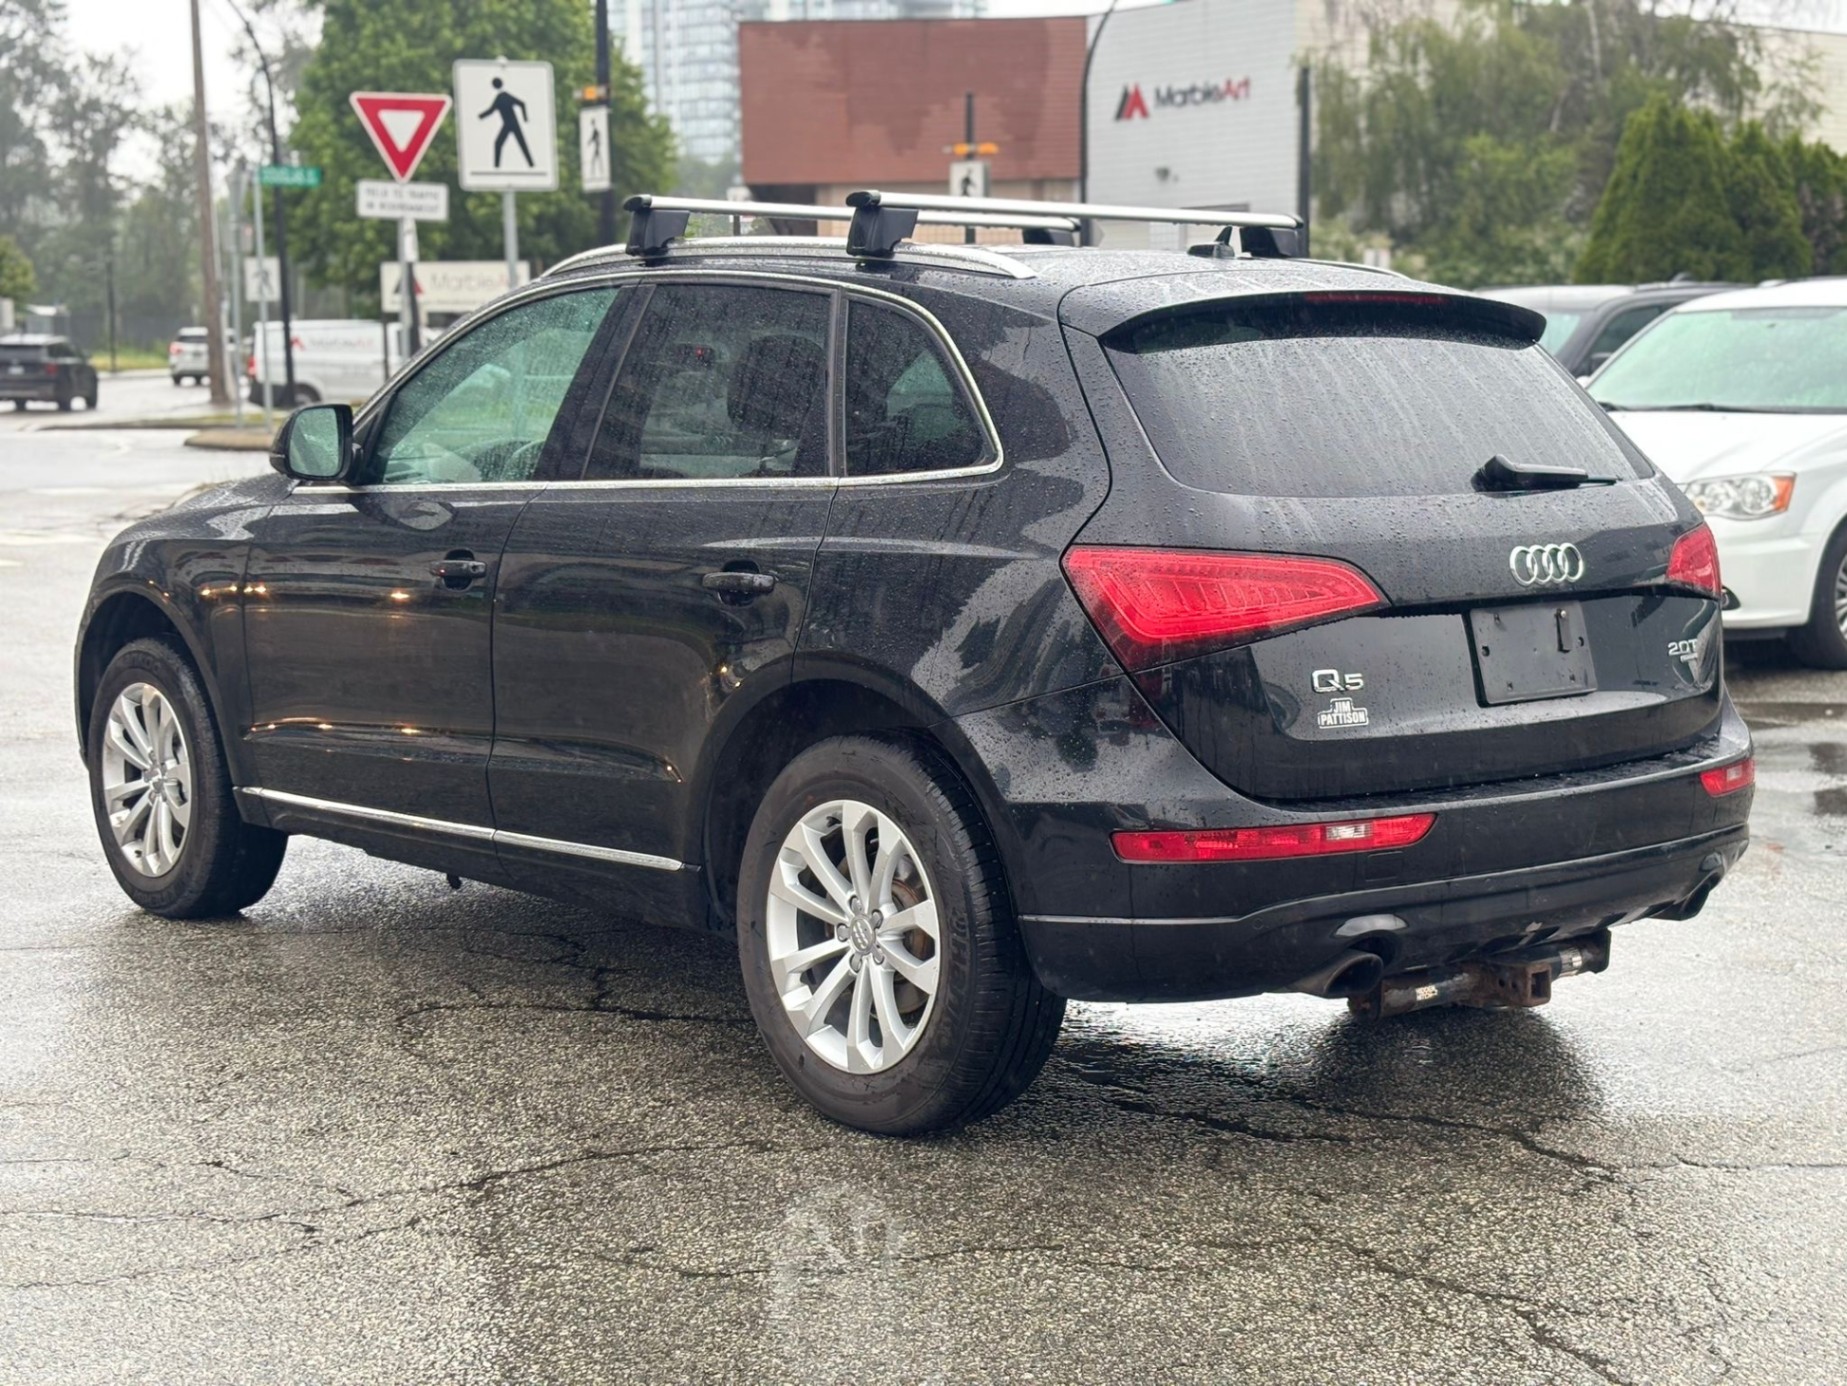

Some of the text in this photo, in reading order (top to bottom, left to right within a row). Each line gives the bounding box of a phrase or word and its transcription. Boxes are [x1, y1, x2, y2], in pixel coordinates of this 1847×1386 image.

[1311, 668, 1364, 693] Q5
[1333, 700, 1352, 713] JIM
[1320, 711, 1366, 726] PATTISON
